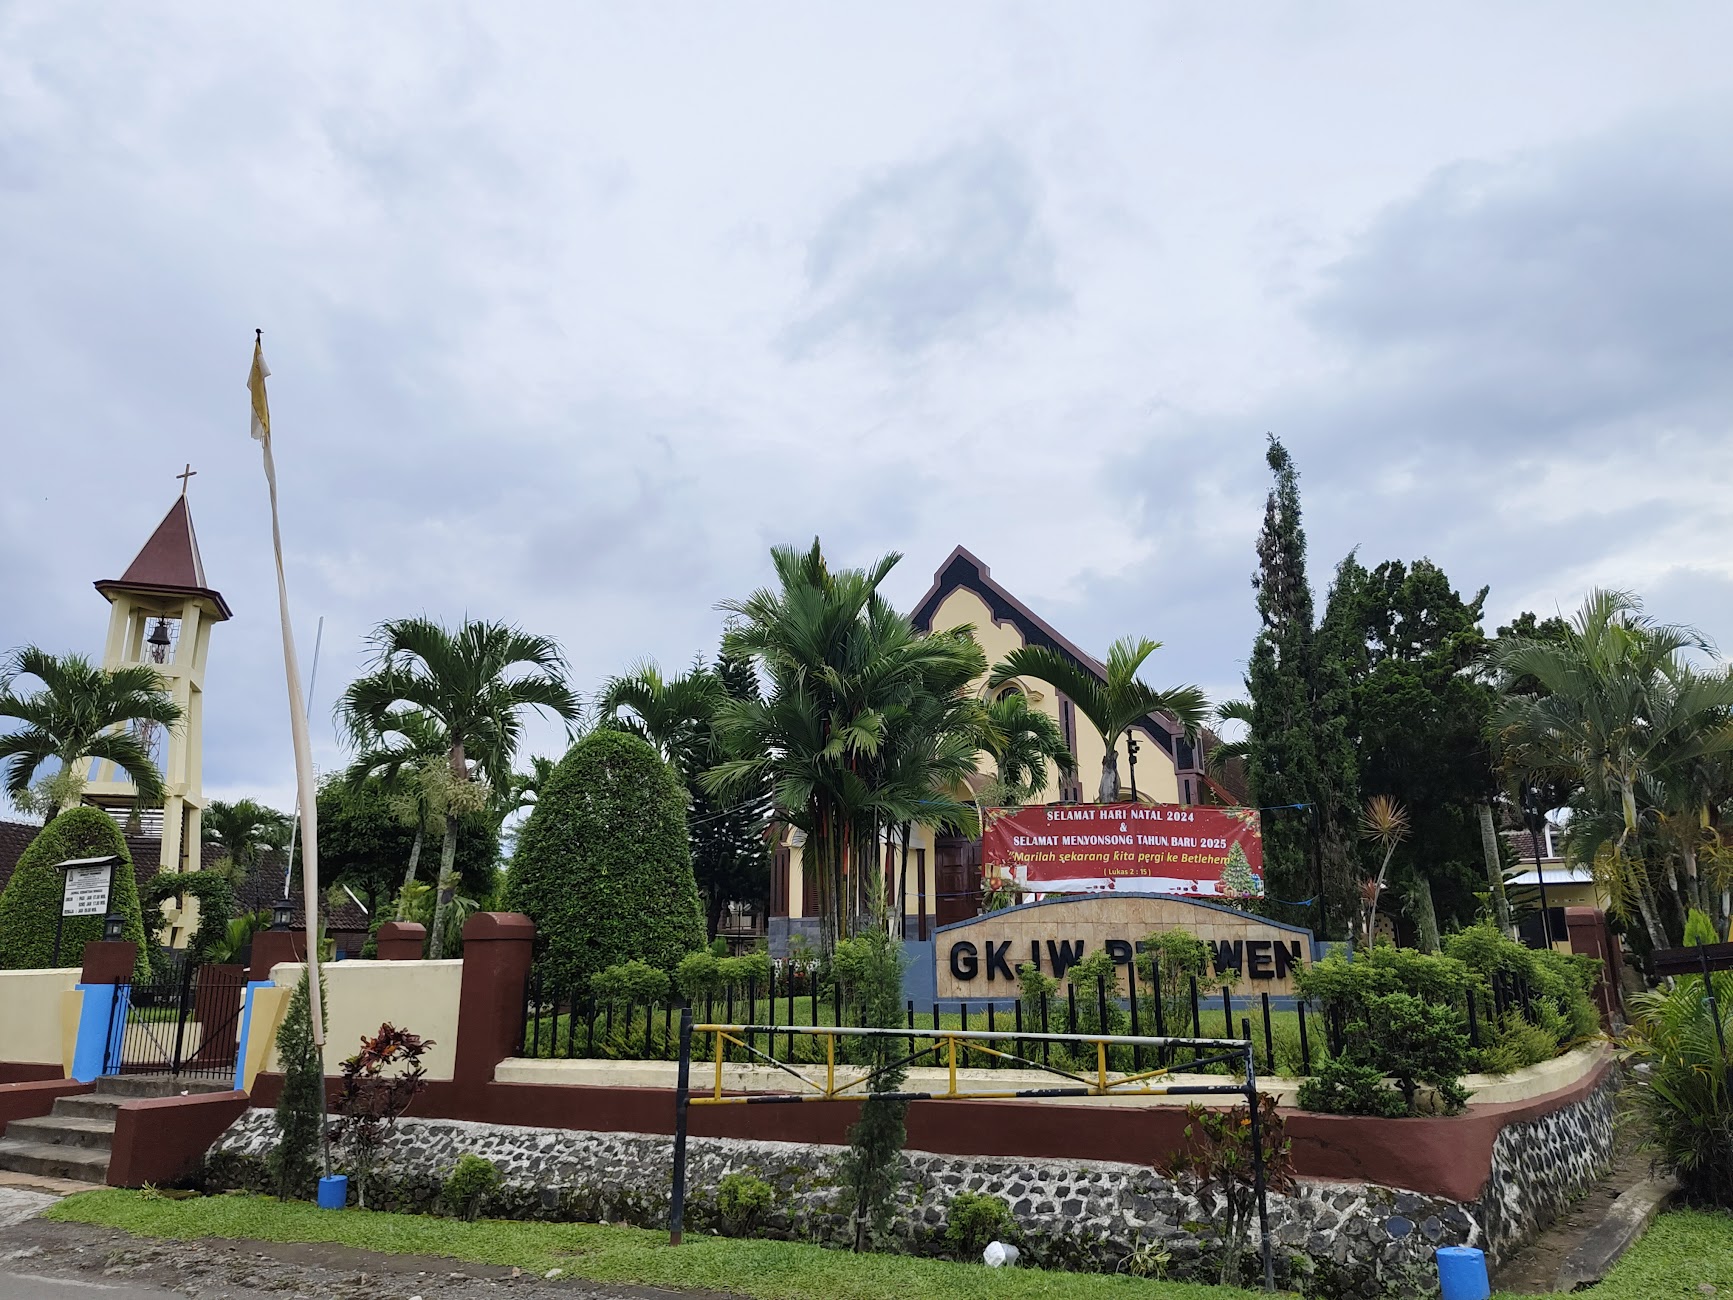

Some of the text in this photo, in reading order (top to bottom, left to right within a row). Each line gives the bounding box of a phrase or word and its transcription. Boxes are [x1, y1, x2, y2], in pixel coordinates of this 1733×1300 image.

[1046, 809, 1195, 823] SELAMAT HARI NATAL 2024
[1119, 822, 1128, 833] &
[1013, 834, 1227, 849] SELAMAT MENYONSONG TAHUN BARU 2025
[1058, 850, 1110, 864] sekarang
[1113, 850, 1135, 862] kita
[1137, 852, 1165, 865] pergi
[1166, 853, 1179, 864] ke
[1108, 868, 1129, 876] Lukas
[950, 938, 1302, 981] GKJW PWEN
